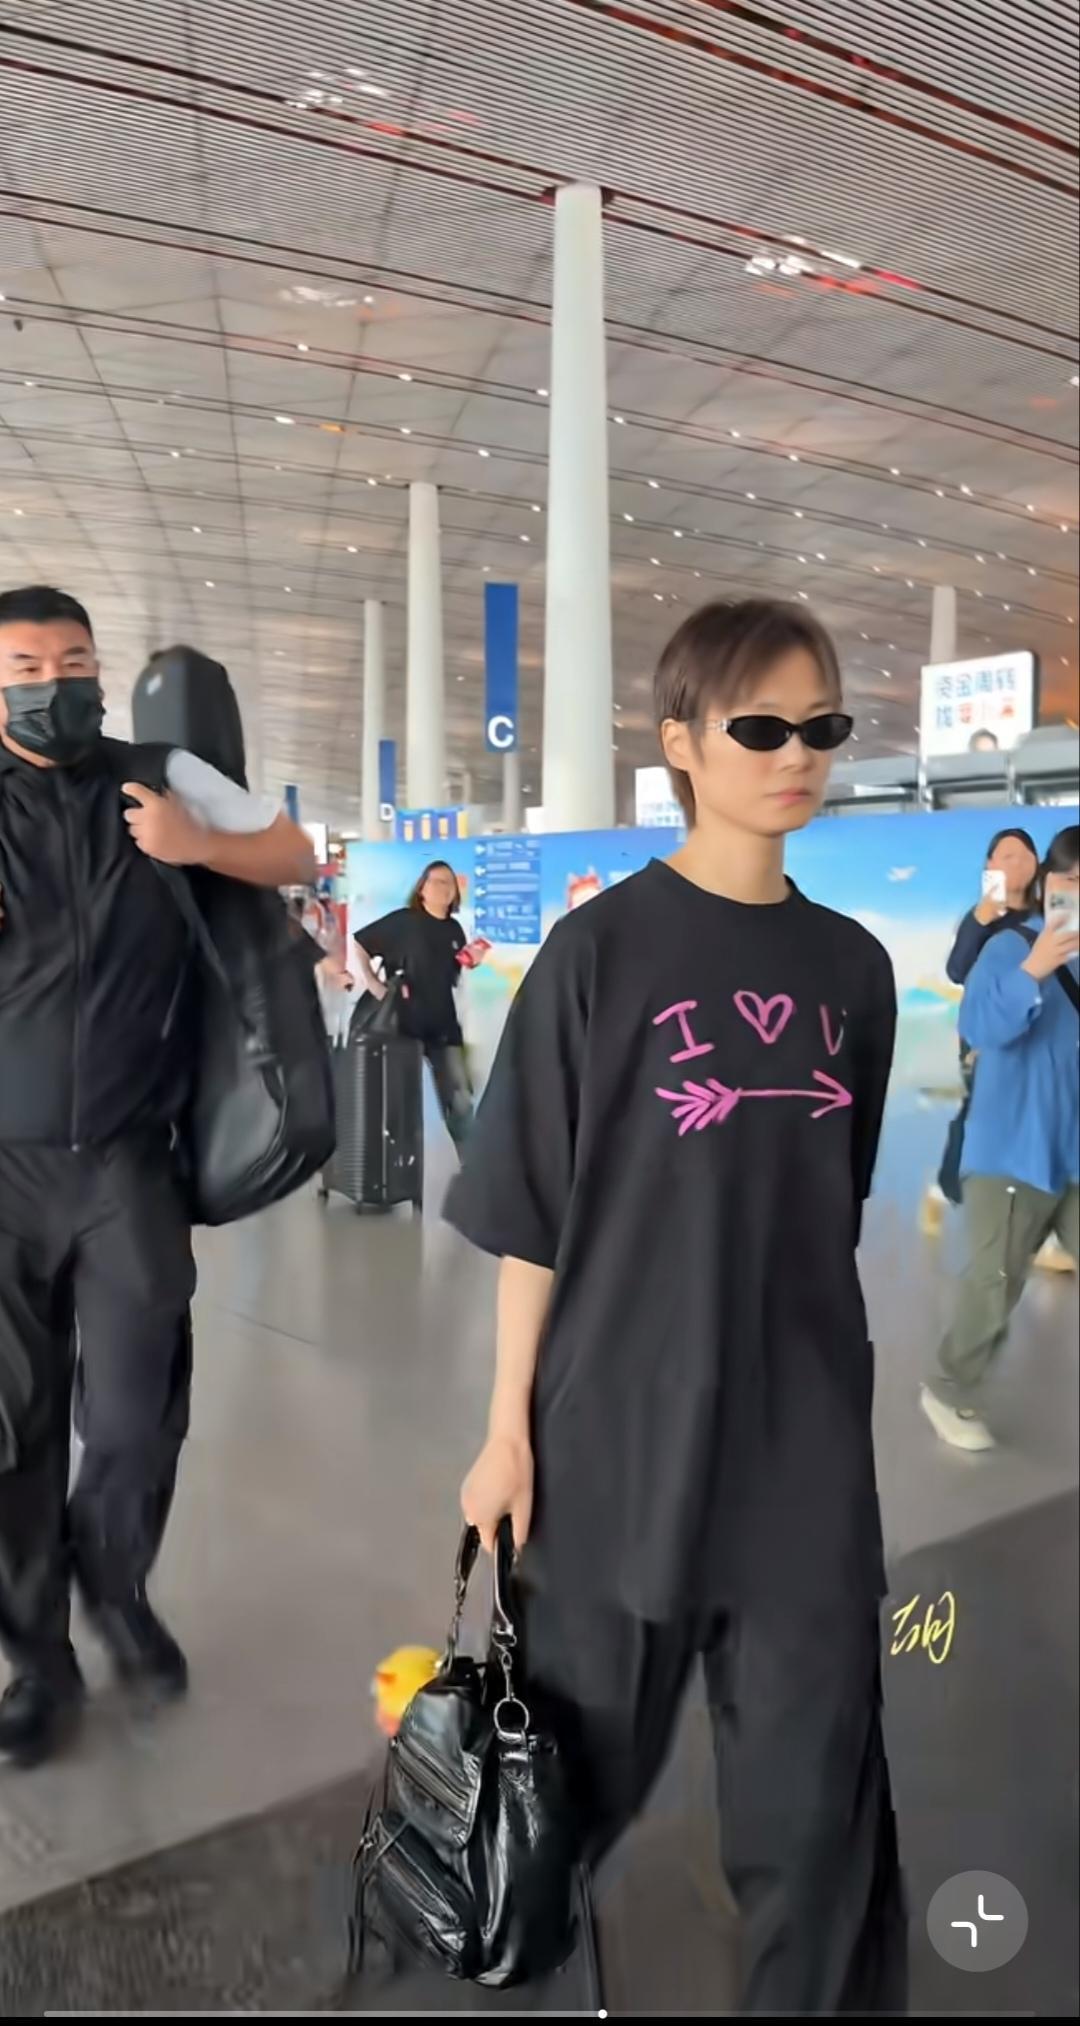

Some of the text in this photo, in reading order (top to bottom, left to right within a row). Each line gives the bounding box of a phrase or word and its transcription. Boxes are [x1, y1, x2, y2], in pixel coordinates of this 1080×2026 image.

[487, 715, 515, 748] C
[380, 803, 395, 820] D
[652, 1000, 714, 1063] I
